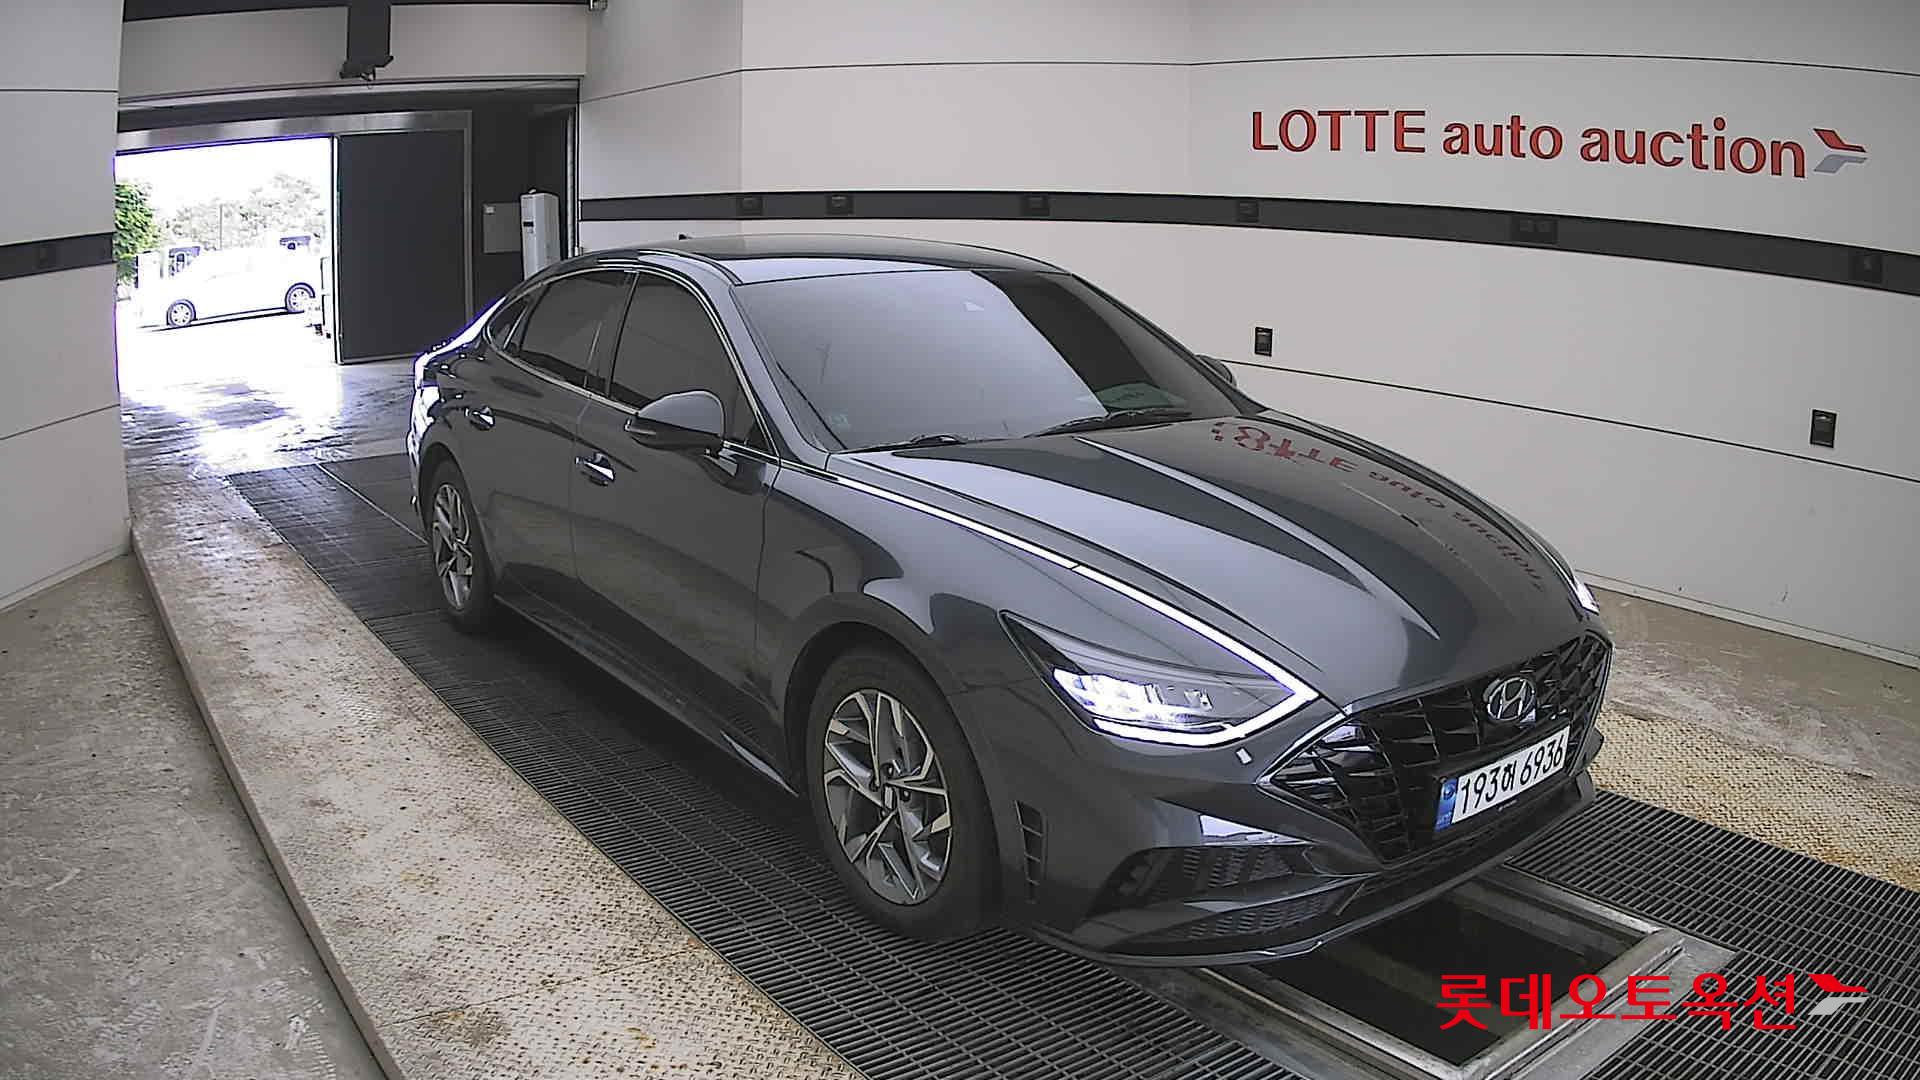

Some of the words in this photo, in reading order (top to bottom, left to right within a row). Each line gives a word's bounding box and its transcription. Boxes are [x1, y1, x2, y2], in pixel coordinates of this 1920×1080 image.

[1251, 109, 1427, 153] LOTTE
[1442, 115, 1564, 160] auto
[1579, 117, 1806, 179] auction
[1461, 760, 1518, 814] 193허
[1519, 734, 1565, 786] 6936
